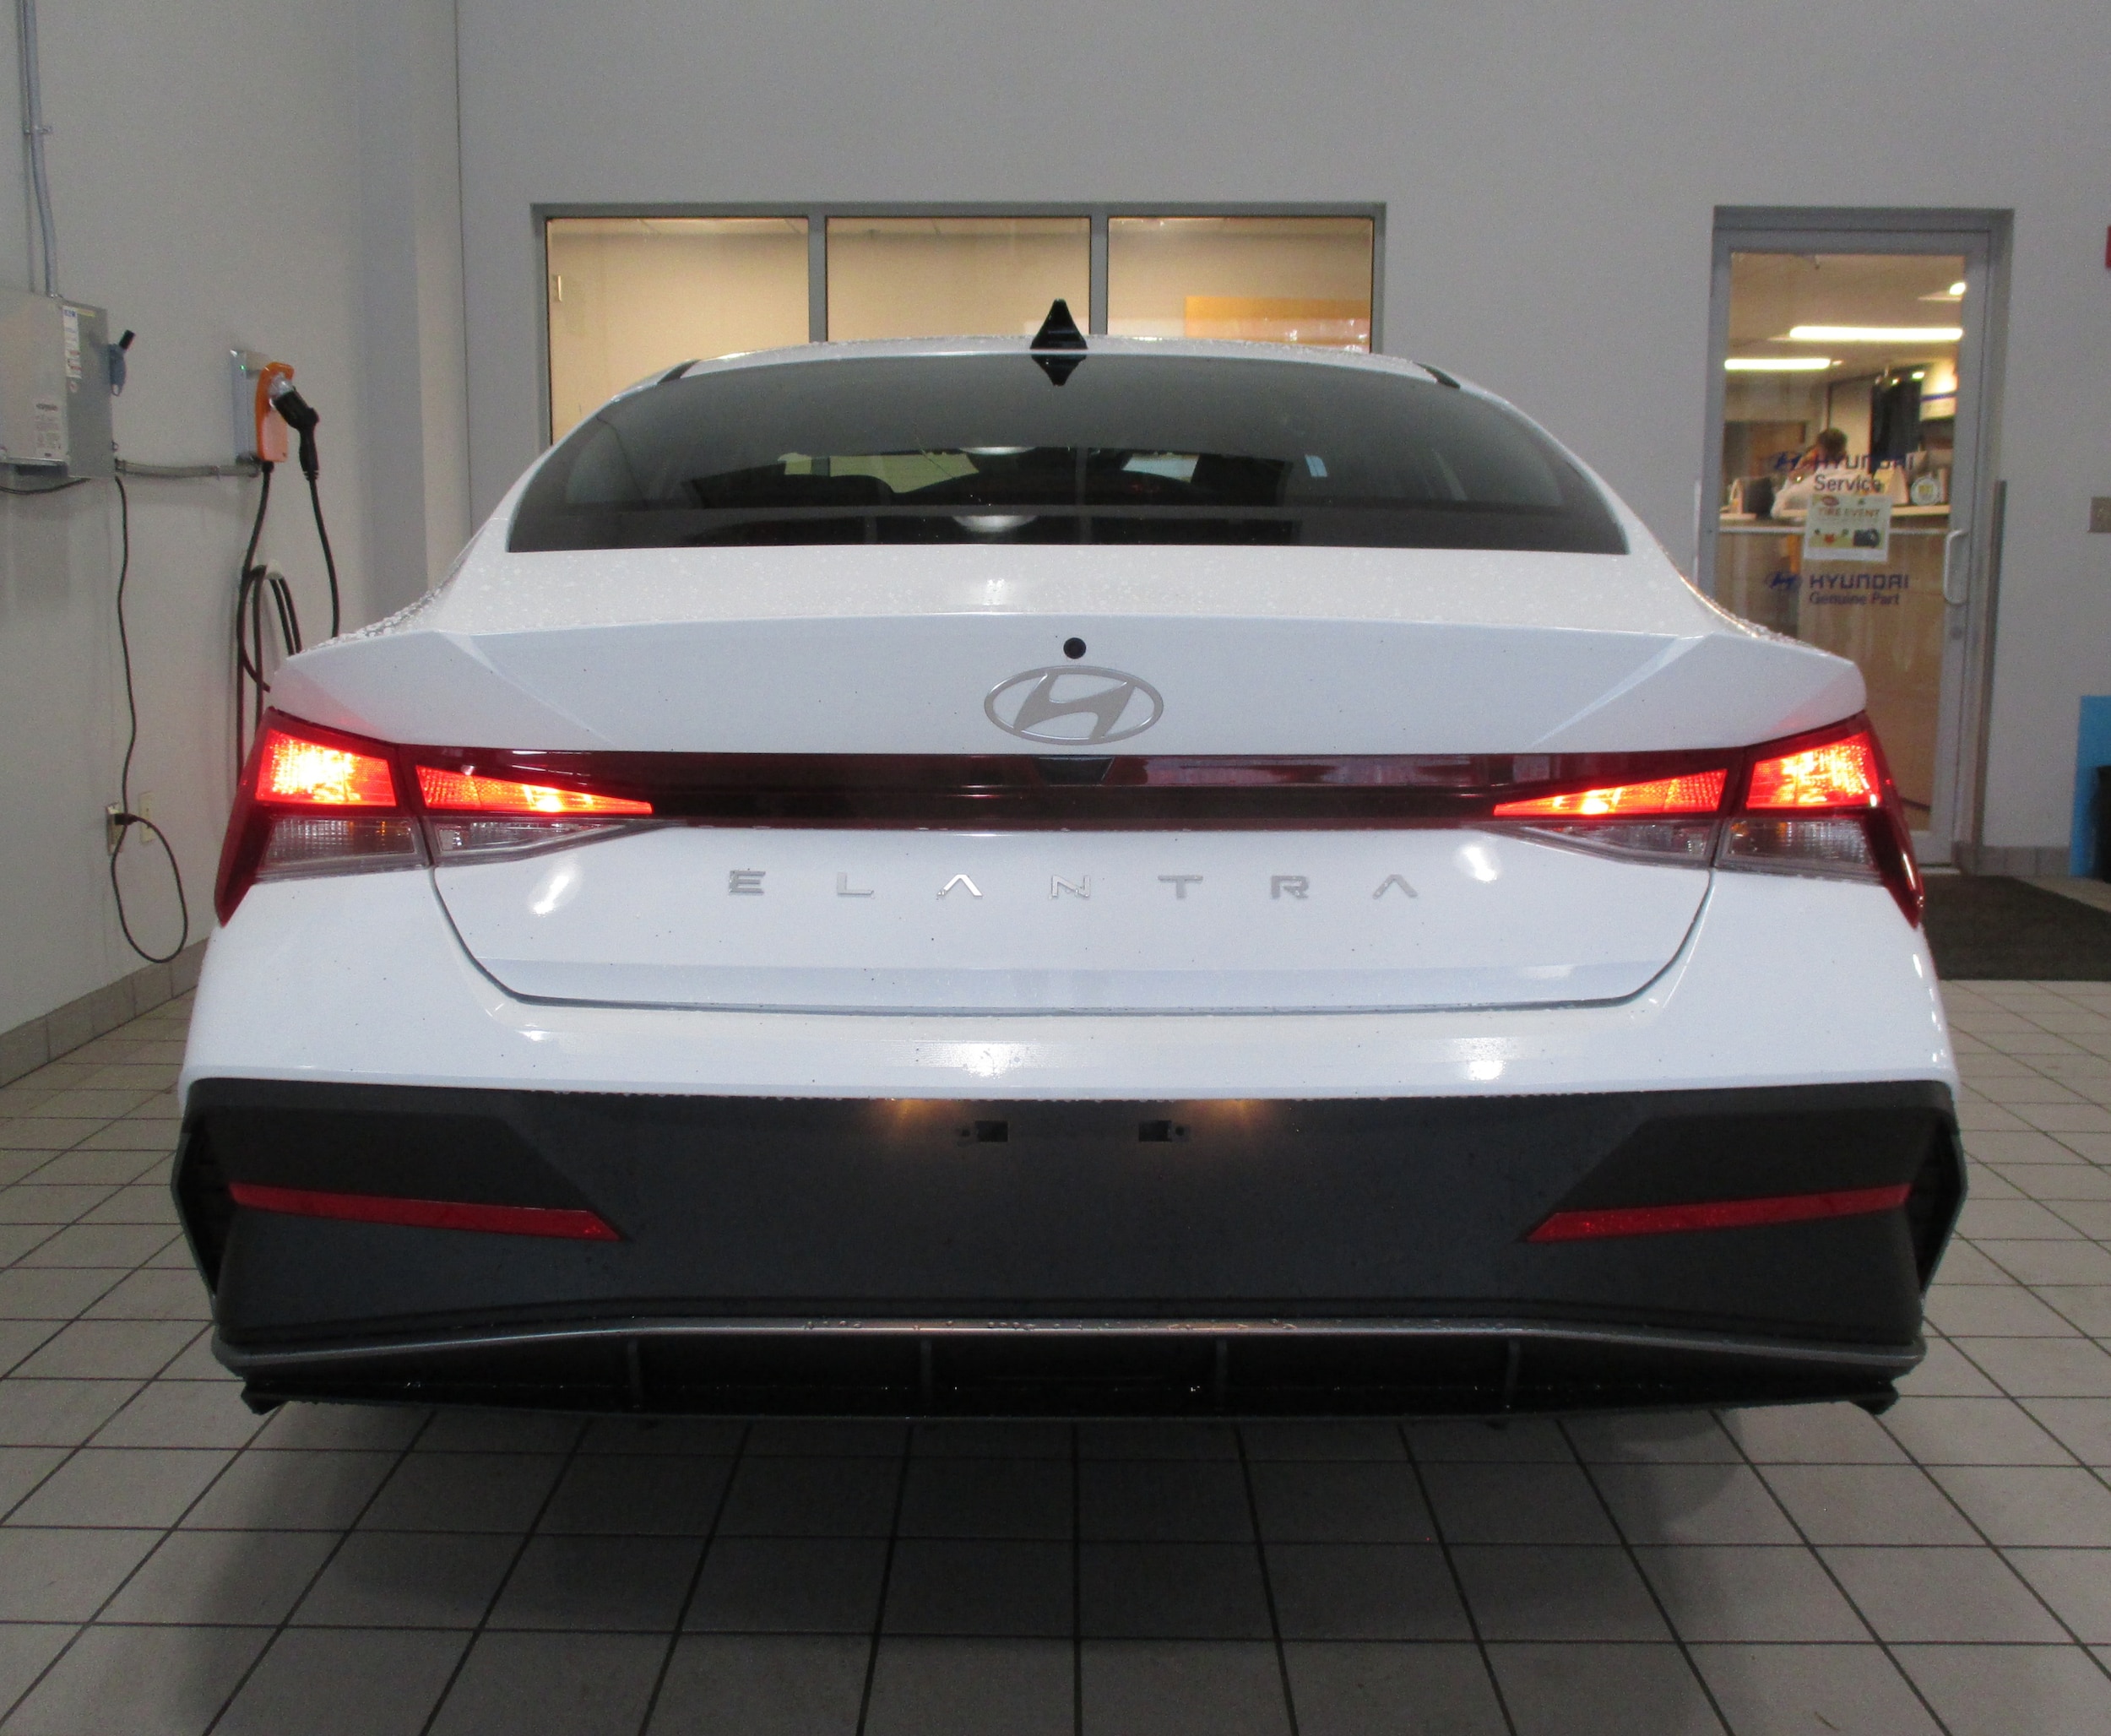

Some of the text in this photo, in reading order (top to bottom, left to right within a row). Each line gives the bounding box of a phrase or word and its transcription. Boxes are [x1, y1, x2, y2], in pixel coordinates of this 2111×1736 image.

[1815, 474, 1882, 491] Service
[1810, 573, 1909, 589] HYUNDAI
[728, 870, 1419, 899] ELANTRA
